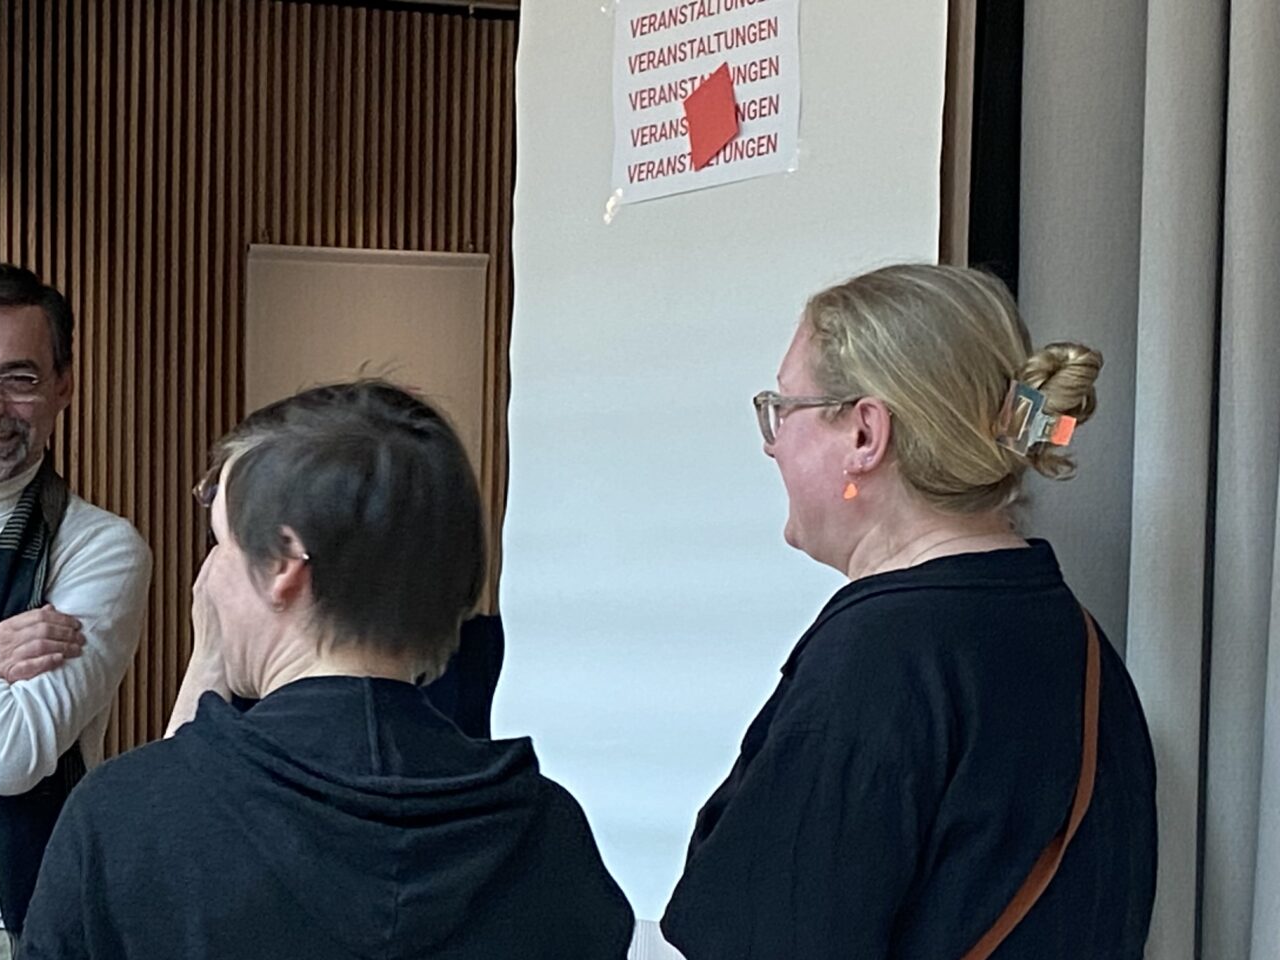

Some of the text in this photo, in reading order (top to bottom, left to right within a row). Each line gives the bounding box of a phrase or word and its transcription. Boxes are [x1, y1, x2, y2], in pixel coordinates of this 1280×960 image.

[628, 16, 778, 75] VERANSTALTUNGEN
[630, 0, 770, 38] VERANSTALTU
[629, 55, 780, 111] VERANSTNGEN
[630, 94, 780, 147] VERANSNGEN
[627, 132, 778, 184] VERANSTUNGEN
